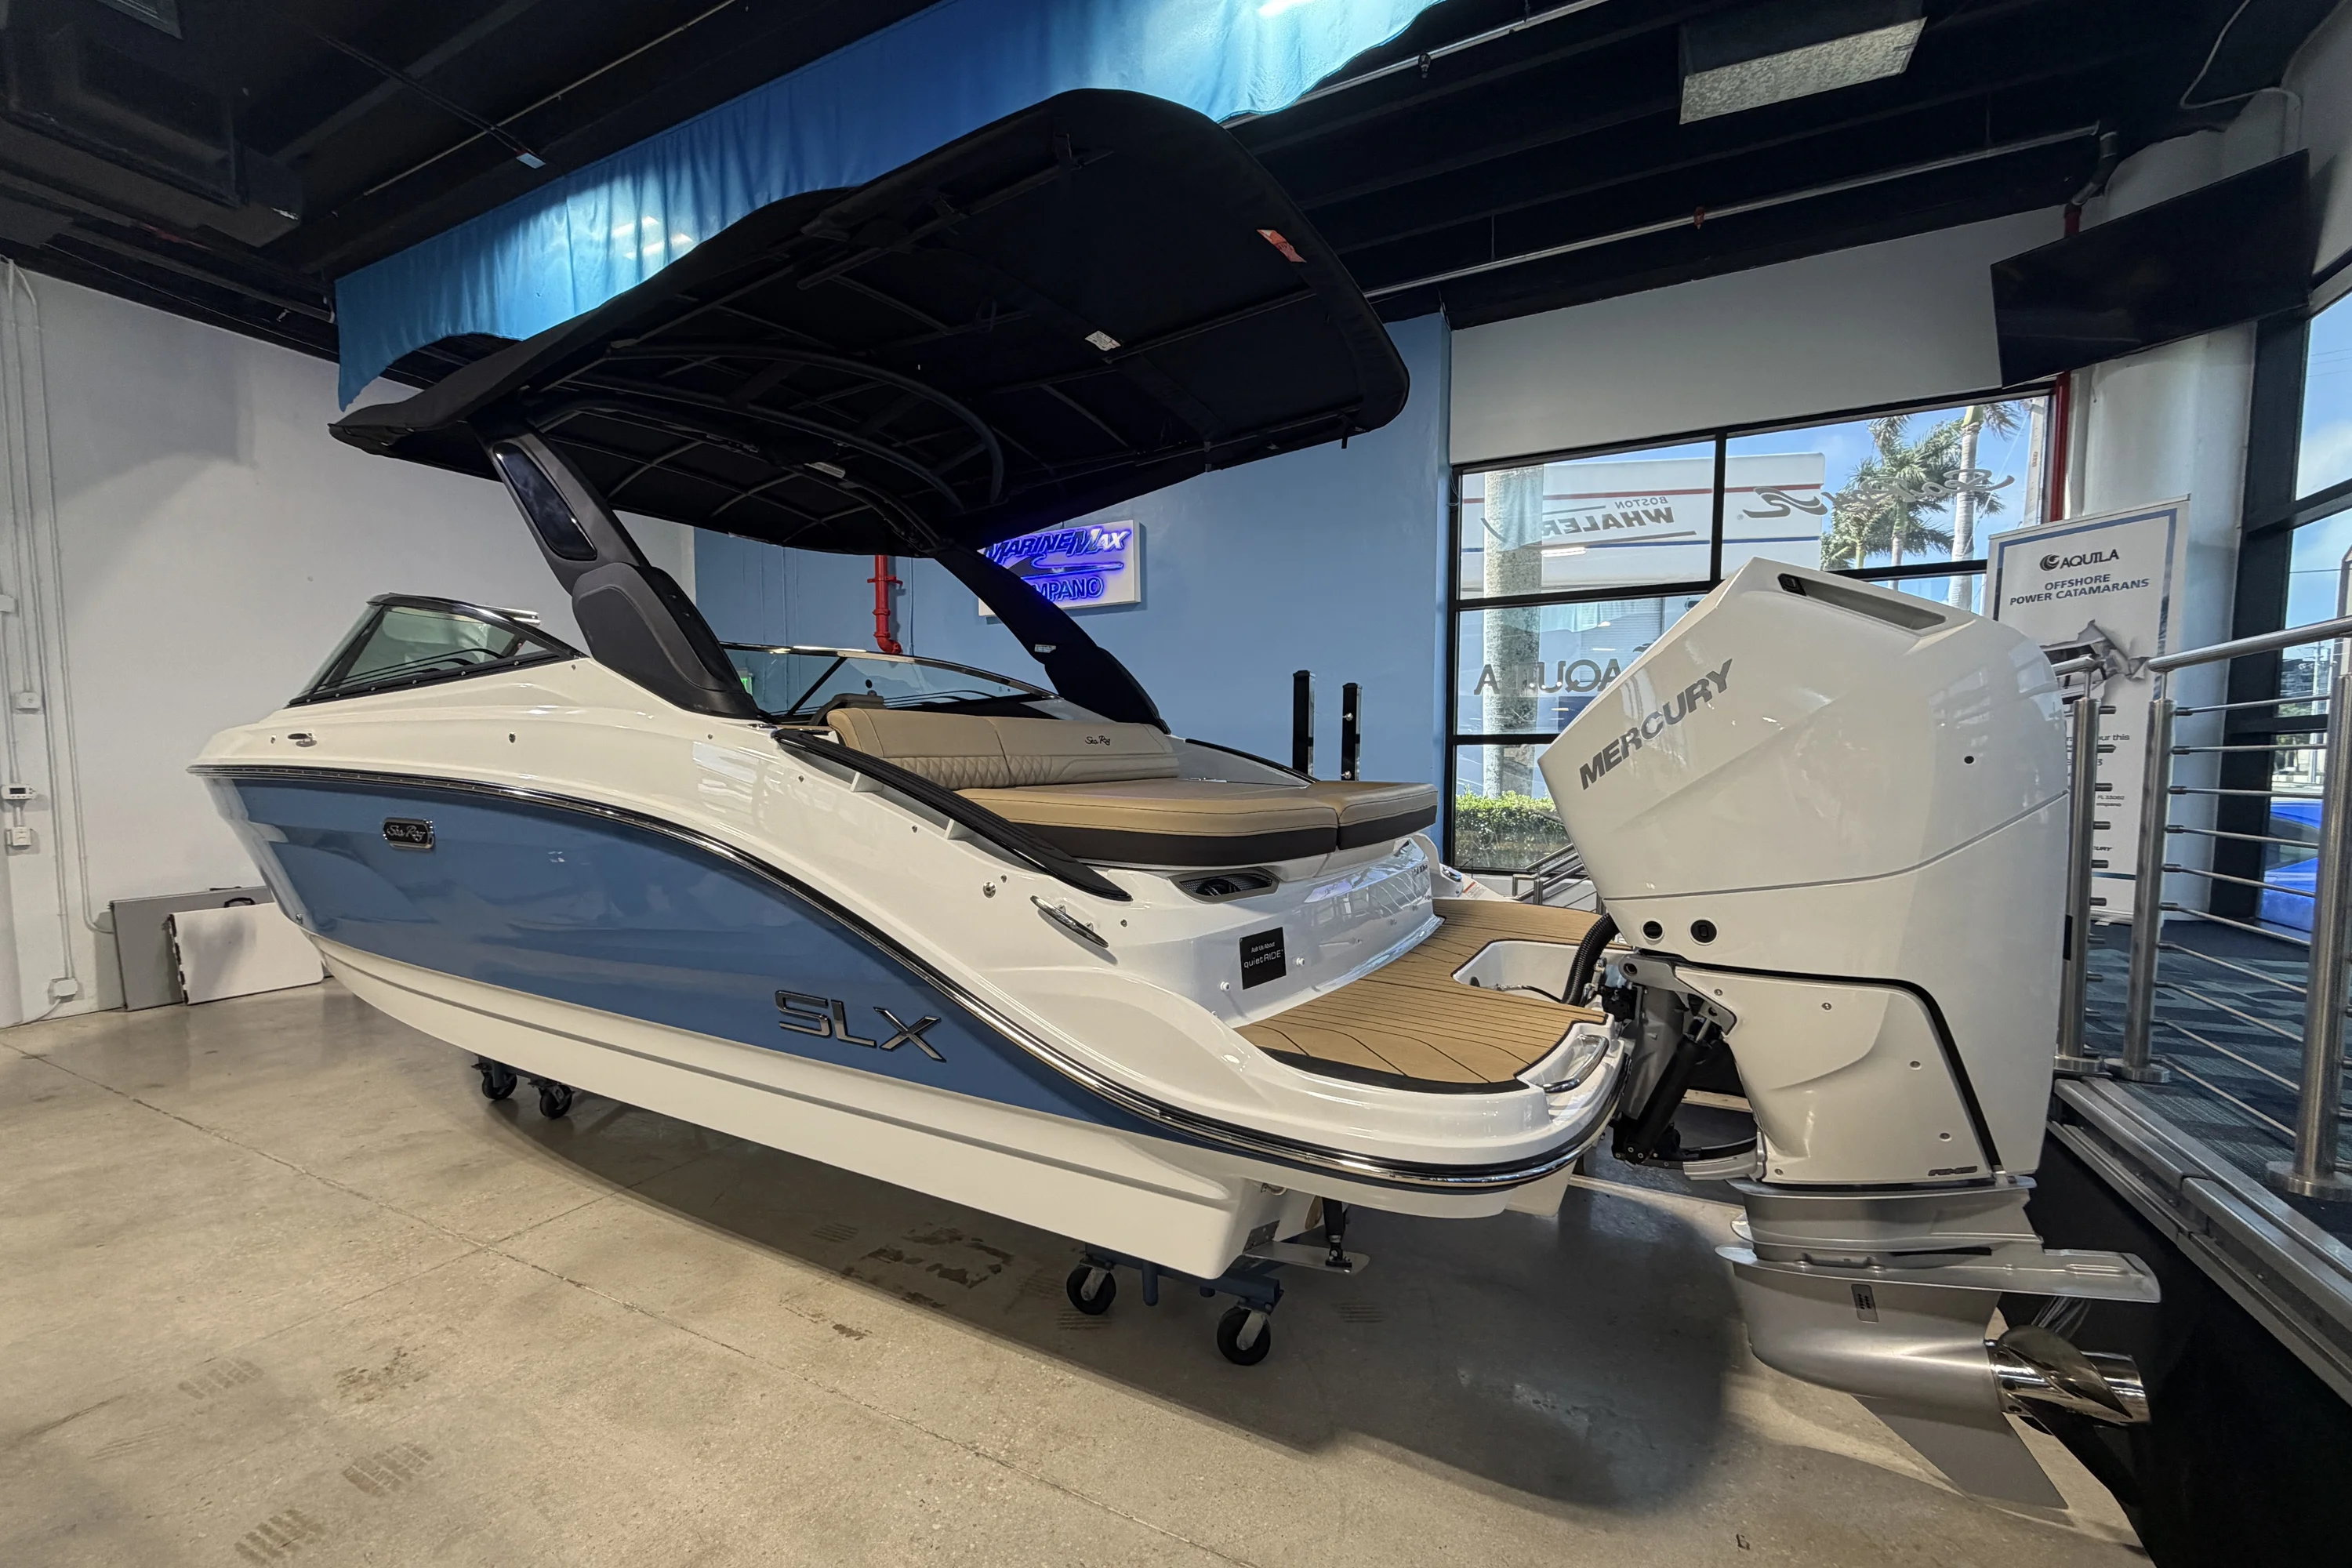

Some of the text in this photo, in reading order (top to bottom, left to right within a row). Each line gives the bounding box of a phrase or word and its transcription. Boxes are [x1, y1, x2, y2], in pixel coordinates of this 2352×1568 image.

[2060, 549, 2119, 569] AQUILA
[2009, 578, 2150, 606] POWER CATAMARANS
[2045, 574, 2111, 591] OFFSHORE
[1579, 658, 1733, 790] MERCURY
[775, 989, 947, 1063] SLX
